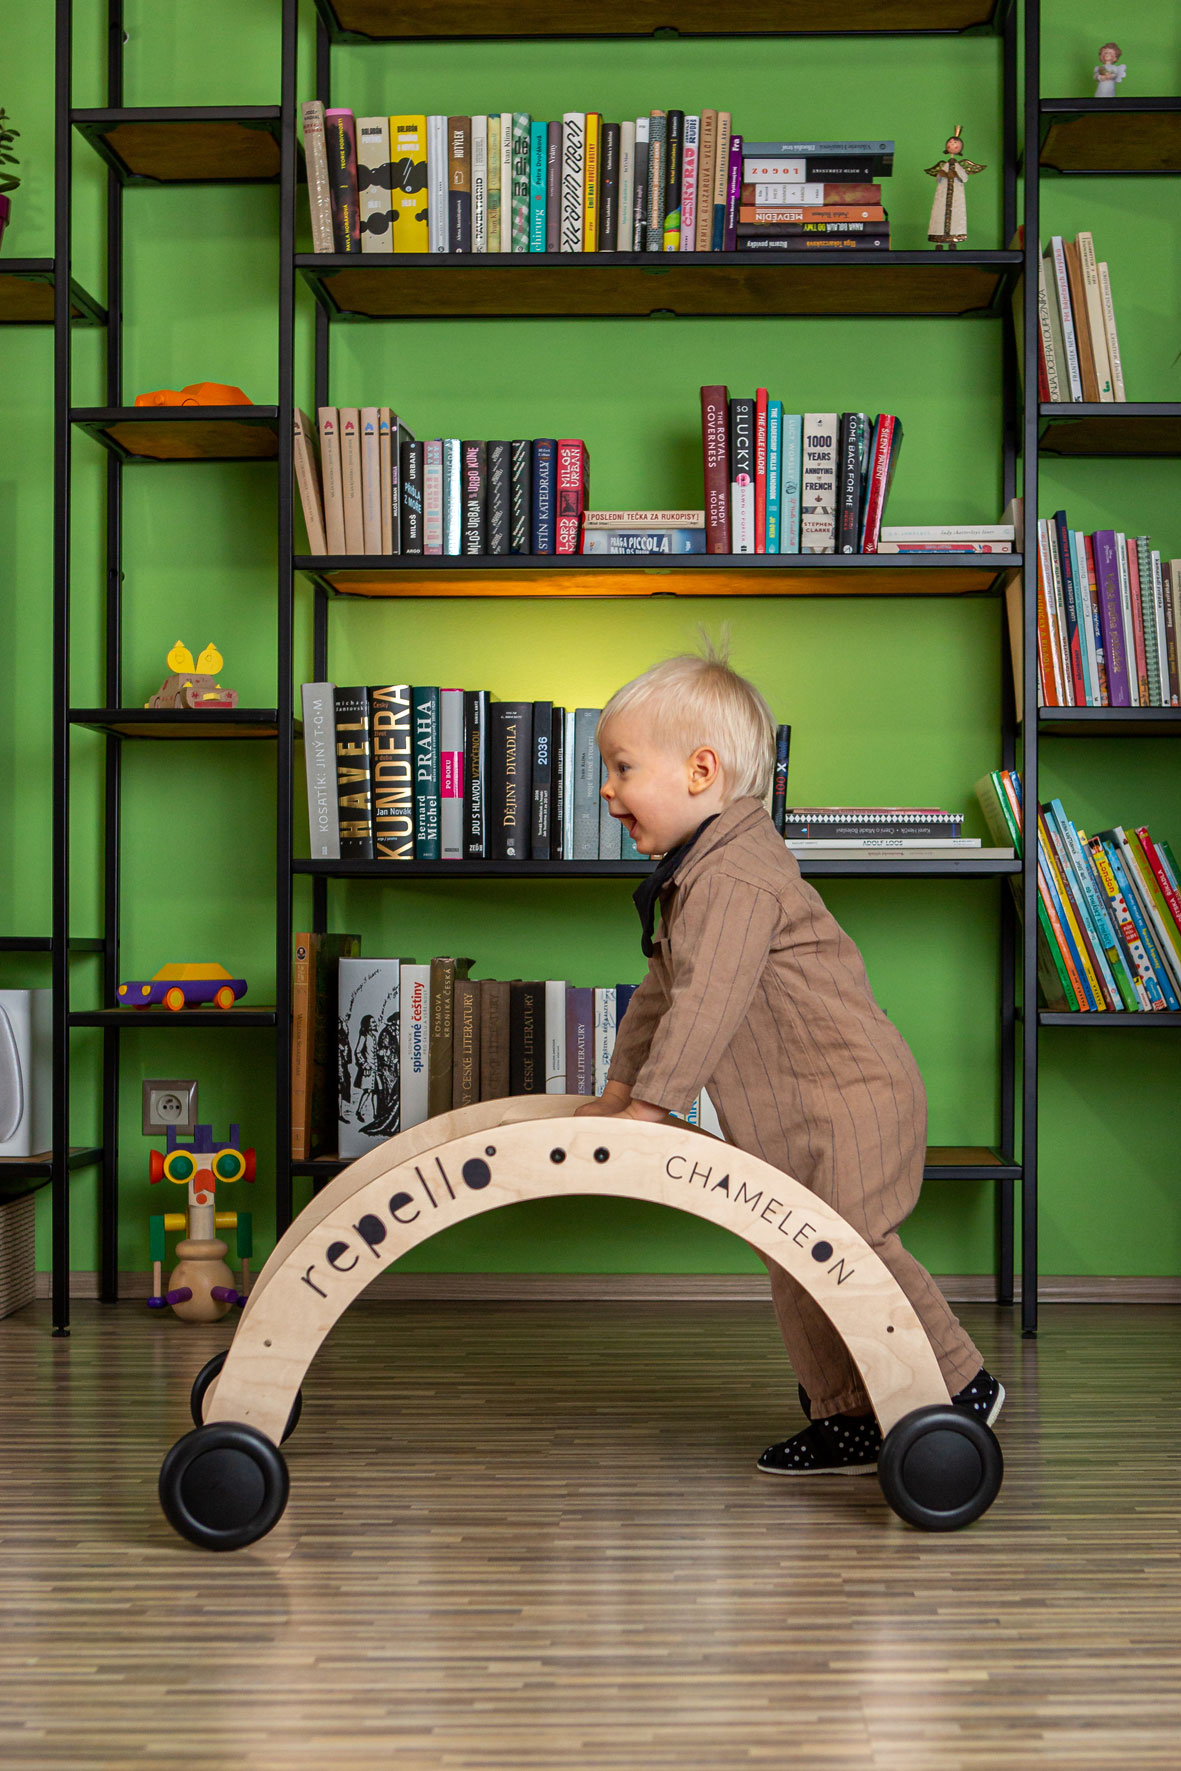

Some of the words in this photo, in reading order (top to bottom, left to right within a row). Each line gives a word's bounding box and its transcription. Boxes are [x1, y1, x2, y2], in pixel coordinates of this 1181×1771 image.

[703, 115, 713, 136] JÁMA
[452, 130, 464, 158] HOTÝLEK
[732, 138, 740, 151] Fra
[682, 181, 694, 227] ČESKÝ
[701, 168, 710, 214] GLAZAROVÁ
[755, 213, 803, 222] MEDVĚDÍN
[700, 218, 708, 251] ARMILA
[1069, 348, 1078, 382] FRANTIŠEK
[770, 408, 778, 418] THE
[848, 415, 858, 443] COME
[707, 405, 716, 468] GOVERNESS
[717, 427, 726, 461] ROYAL
[736, 414, 749, 470] LUCKY
[770, 419, 778, 451] LEADERSHIP
[806, 435, 833, 448] 1000
[879, 428, 889, 454] SILENT
[466, 447, 480, 468] KUNE
[560, 449, 570, 487] MILOŠ
[570, 449, 580, 487] URBAN
[807, 452, 832, 461] YEARS
[847, 445, 856, 471] BACK
[875, 455, 886, 480] PATIENT
[468, 470, 481, 492] URBO
[538, 460, 549, 519] KATEDRÁLY
[769, 471, 777, 499] HANDBOOK
[846, 473, 854, 493] FOR
[468, 500, 481, 528] URBAN
[627, 512, 648, 520] TEČKA
[710, 490, 718, 527] HOLDEN
[846, 494, 854, 507] ME
[465, 530, 482, 554] MILOŠ
[537, 523, 549, 549] STÍN
[559, 518, 569, 551] LORD
[610, 537, 628, 547] PRAGA
[628, 537, 670, 552] PICCOLA
[312, 740, 326, 768] JINÝ
[417, 700, 432, 782] PRAHA
[470, 731, 480, 778] VZTYČENOU
[506, 724, 516, 775] DIVADLA
[537, 736, 549, 765] 2036
[336, 717, 372, 838] HAVEL
[373, 684, 413, 859] KUNDERA
[445, 777, 451, 789] PO
[775, 776, 786, 796] 100
[472, 779, 480, 812] HLAVOU
[503, 781, 517, 826] DĚJINY
[376, 808, 388, 816] Jan
[417, 795, 426, 840] Bernard
[427, 795, 437, 840] Michel
[472, 820, 481, 836] JDU
[1098, 860, 1116, 893] London
[443, 968, 452, 996] ČESKÁ
[411, 981, 426, 1021] češtiny
[463, 992, 473, 1054] LITERATURY
[523, 993, 534, 1054] LITERATURY
[411, 1024, 427, 1073] spisovné
[577, 1023, 585, 1072] LITERATURY
[577, 1074, 585, 1094] ESKÉ
[299, 1156, 493, 1299] repello
[665, 1155, 855, 1287] CHAMELEON
